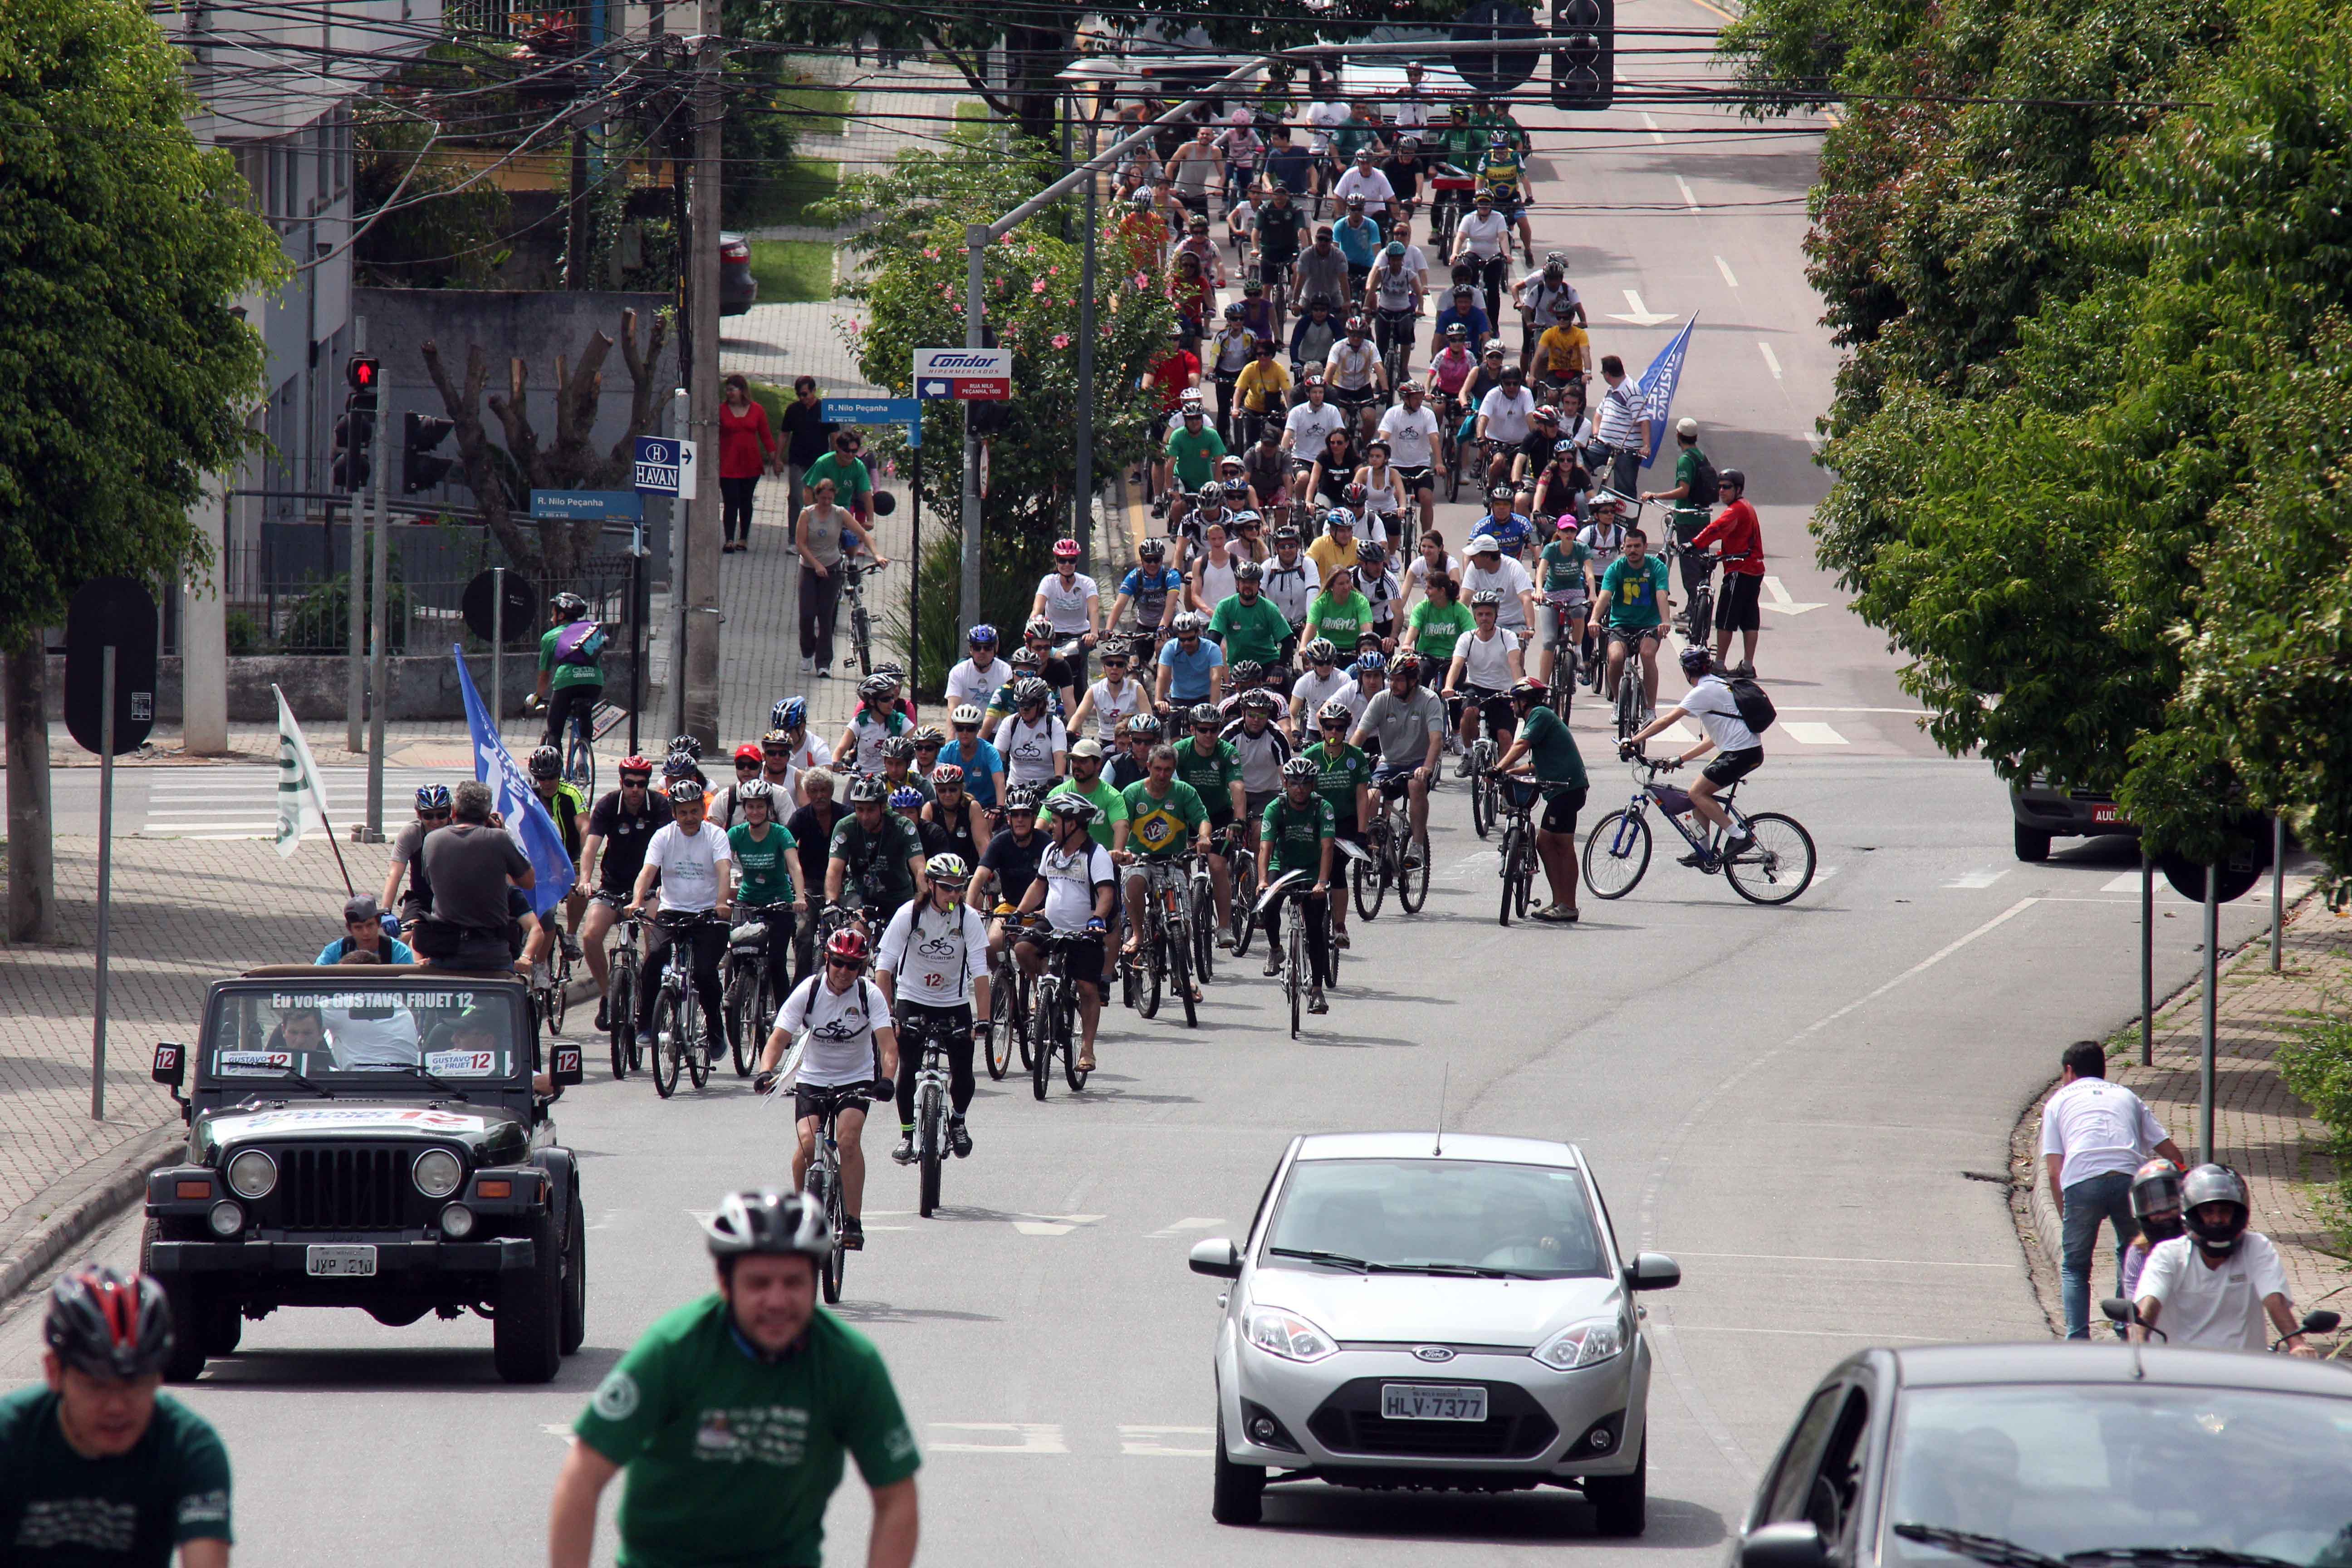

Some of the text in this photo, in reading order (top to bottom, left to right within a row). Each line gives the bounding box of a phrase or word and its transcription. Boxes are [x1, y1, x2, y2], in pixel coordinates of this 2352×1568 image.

[928, 354, 999, 367] Condor
[856, 404, 888, 413] Peçanha
[653, 446, 660, 461] H
[636, 466, 677, 486] HAVAN
[567, 498, 603, 507] Peçanha
[1147, 823, 1160, 838] 12
[924, 973, 942, 986] 12
[272, 993, 291, 1008] Eu
[333, 993, 404, 1008] GUSTAVO
[407, 993, 453, 1008] FRUET
[456, 993, 474, 1008] 12
[158, 1051, 175, 1068] 12
[267, 1054, 288, 1069] 12
[432, 1056, 470, 1064] GUSTAVO
[470, 1053, 491, 1069] 12
[558, 1052, 578, 1071] 12
[1425, 1349, 1445, 1358] Ford
